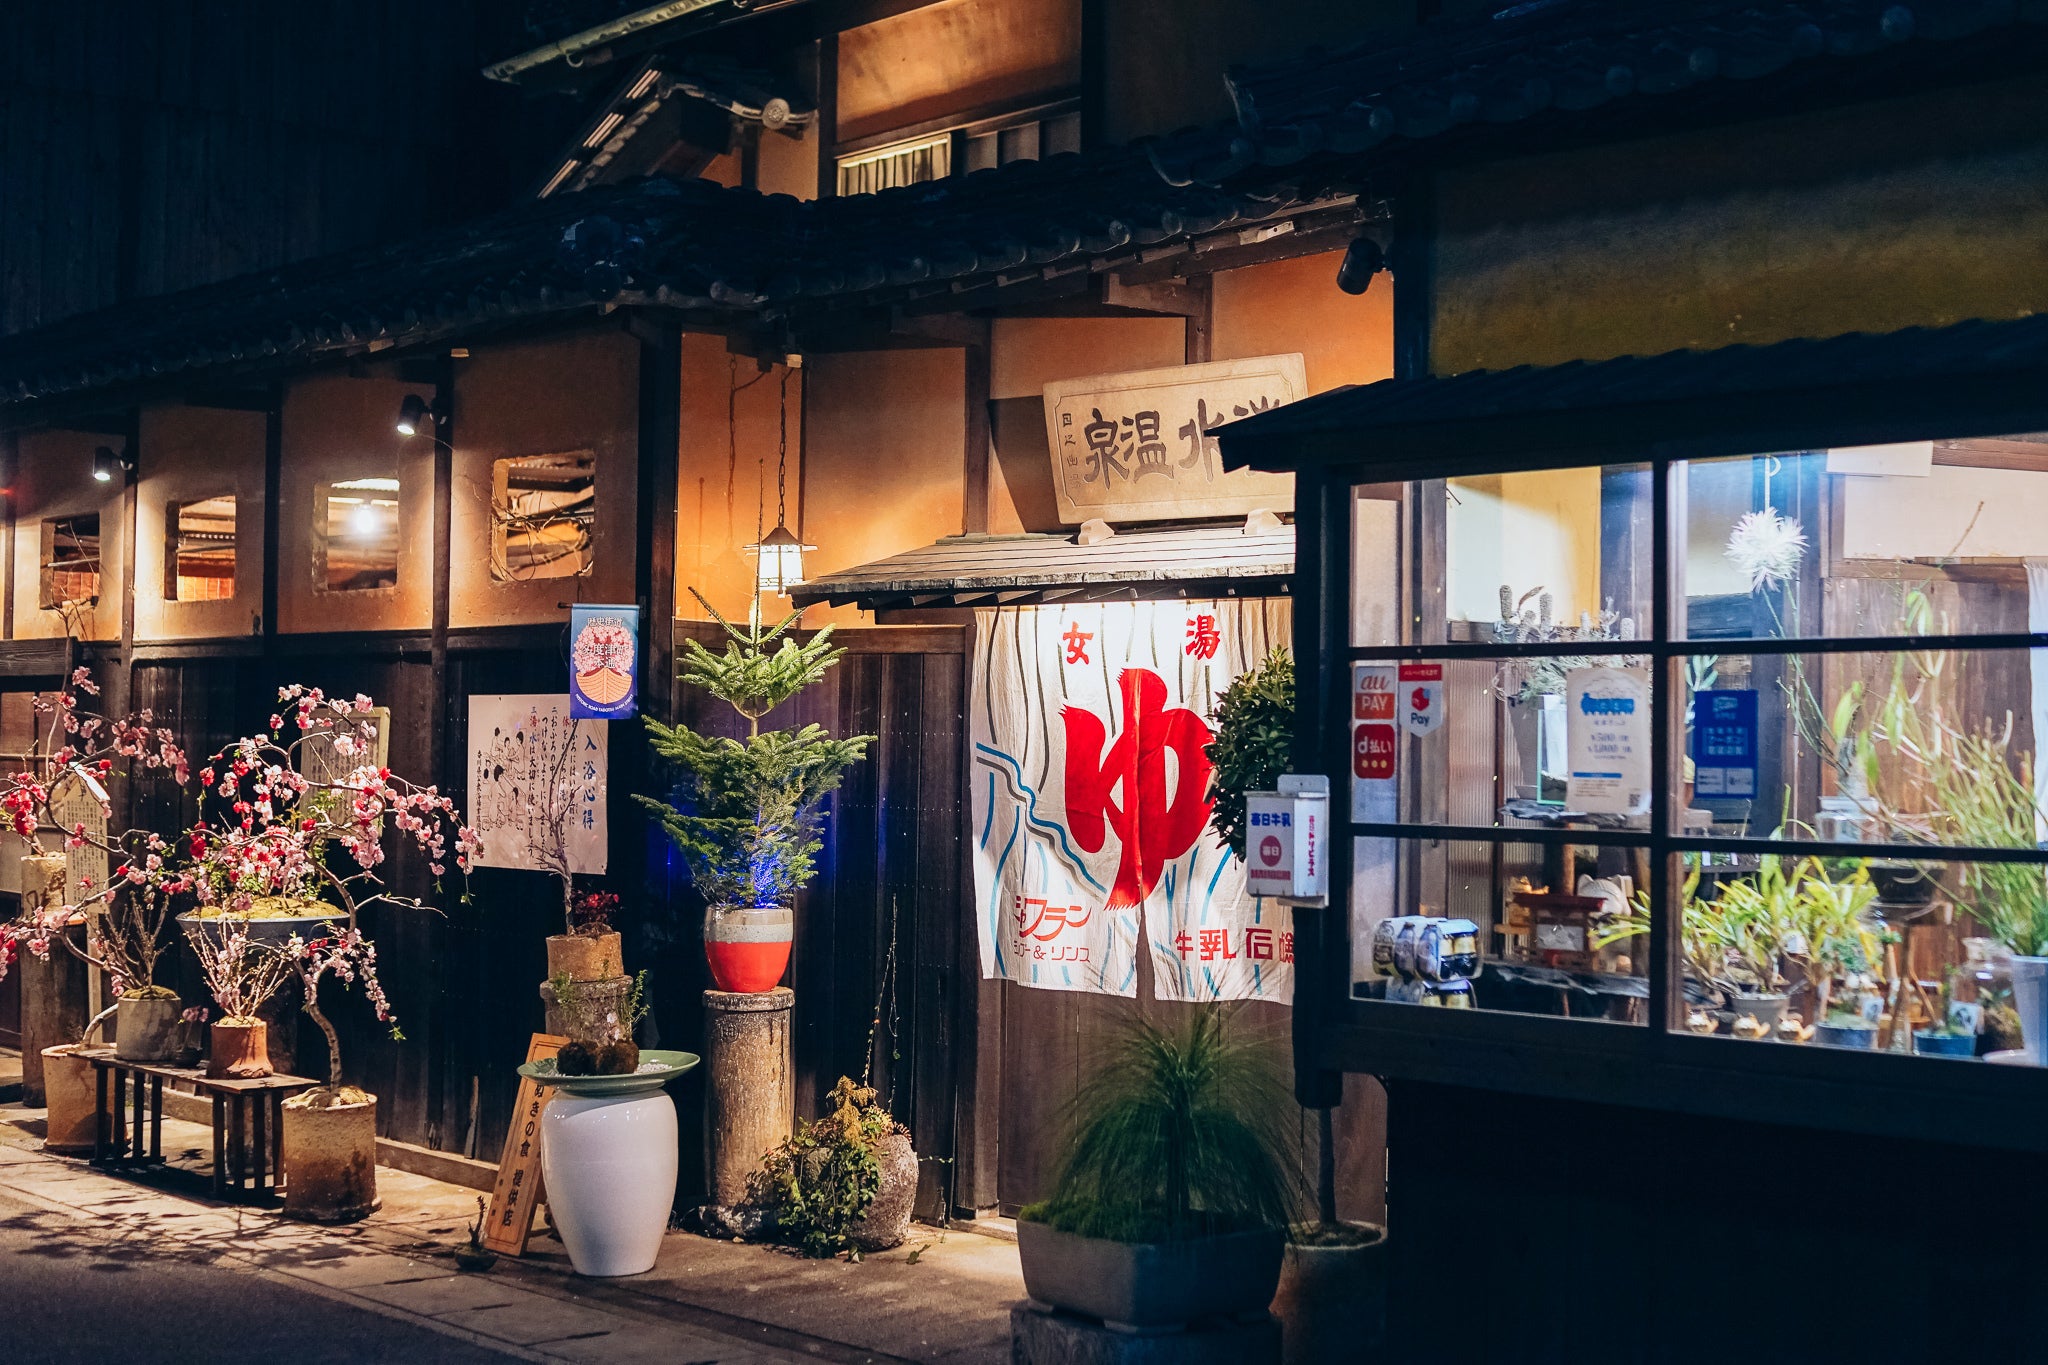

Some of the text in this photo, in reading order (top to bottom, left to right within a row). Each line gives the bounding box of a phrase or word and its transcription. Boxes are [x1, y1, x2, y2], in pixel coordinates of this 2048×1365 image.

[1361, 675, 1389, 690] au
[1362, 695, 1388, 711] PAY
[1410, 712, 1430, 727] Pay
[1358, 736, 1392, 754] d払い
[583, 735, 597, 830] 入浴心得
[1250, 812, 1292, 828] 毎日牛乳
[1033, 945, 1046, 960] &
[1052, 946, 1090, 963] リンス
